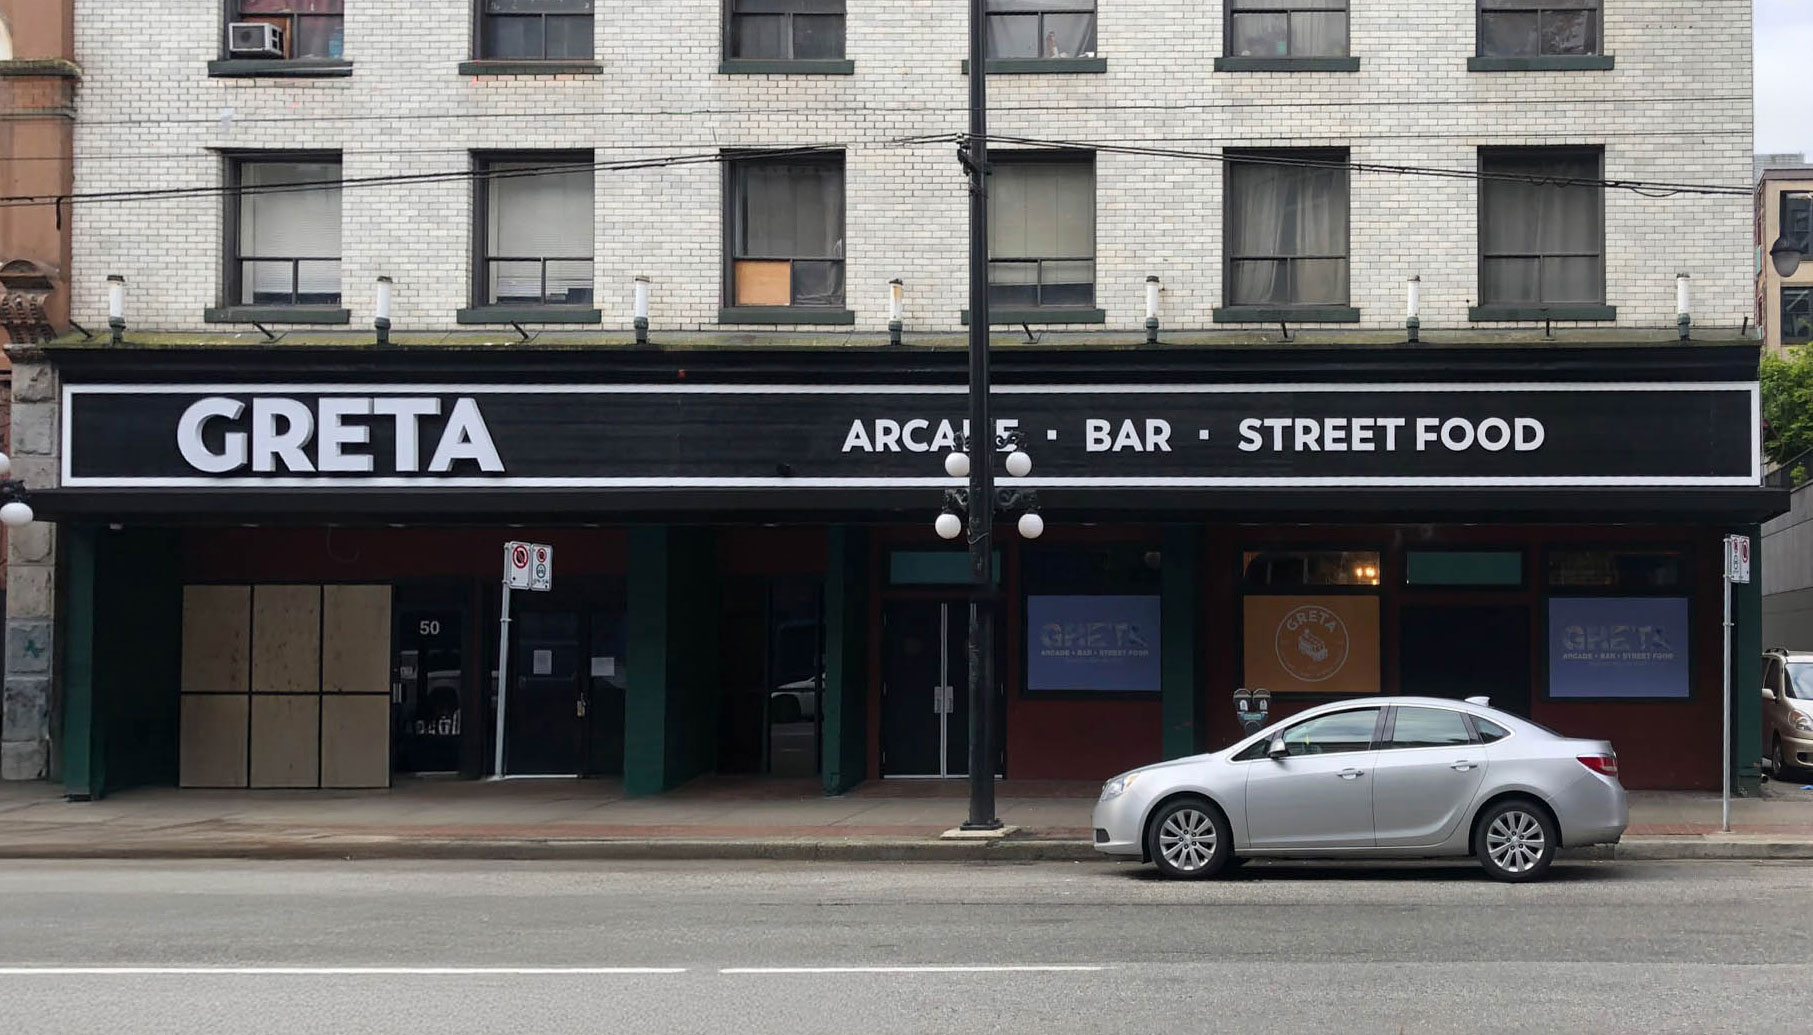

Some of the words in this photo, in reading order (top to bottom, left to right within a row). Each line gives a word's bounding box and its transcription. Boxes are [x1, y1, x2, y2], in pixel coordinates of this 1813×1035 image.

[176, 397, 505, 473] GRETA
[841, 418, 1019, 452] ARCAE
[1085, 418, 1172, 452] BAR
[1237, 416, 1406, 452] STREET
[1416, 416, 1545, 452] FOOD
[419, 620, 440, 636] 50
[1286, 609, 1338, 632] GRETA
